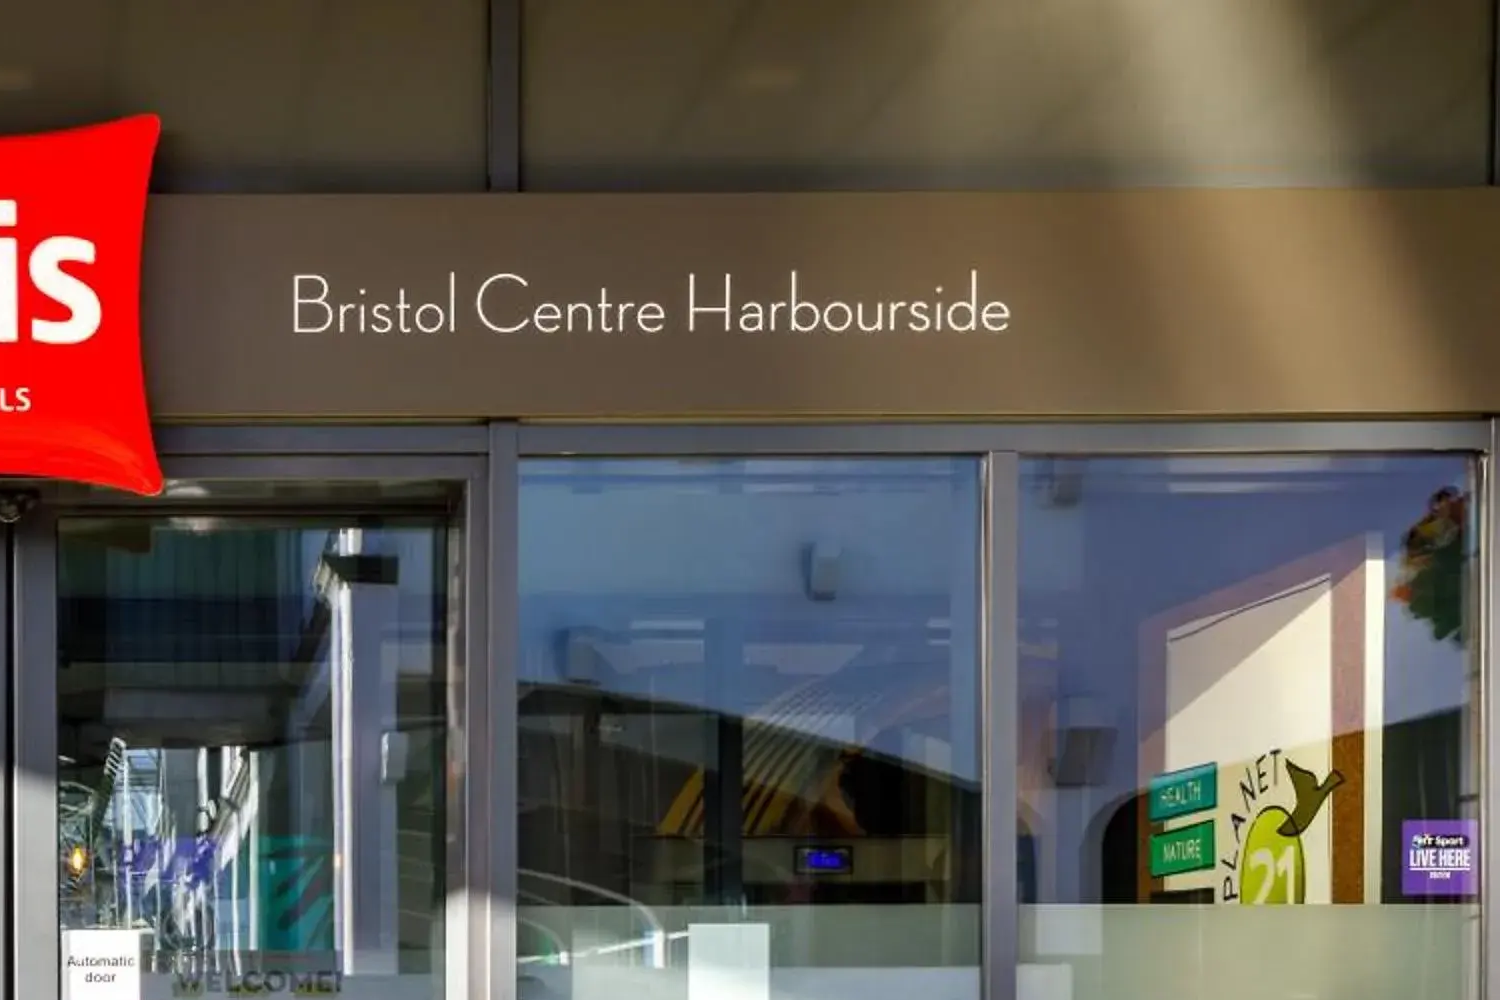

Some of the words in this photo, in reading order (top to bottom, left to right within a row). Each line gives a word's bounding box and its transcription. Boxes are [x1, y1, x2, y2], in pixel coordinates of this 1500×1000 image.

[292, 272, 455, 333] Bristol
[476, 273, 665, 333] Centre
[689, 271, 1011, 332] Harbourside
[1160, 781, 1201, 807] HEALTH
[1163, 838, 1201, 863] NATURE
[1409, 848, 1437, 867] LIVE
[1439, 848, 1471, 867] HERE
[1250, 846, 1295, 904] 21
[67, 955, 135, 968] Automatic
[84, 971, 117, 984] door
